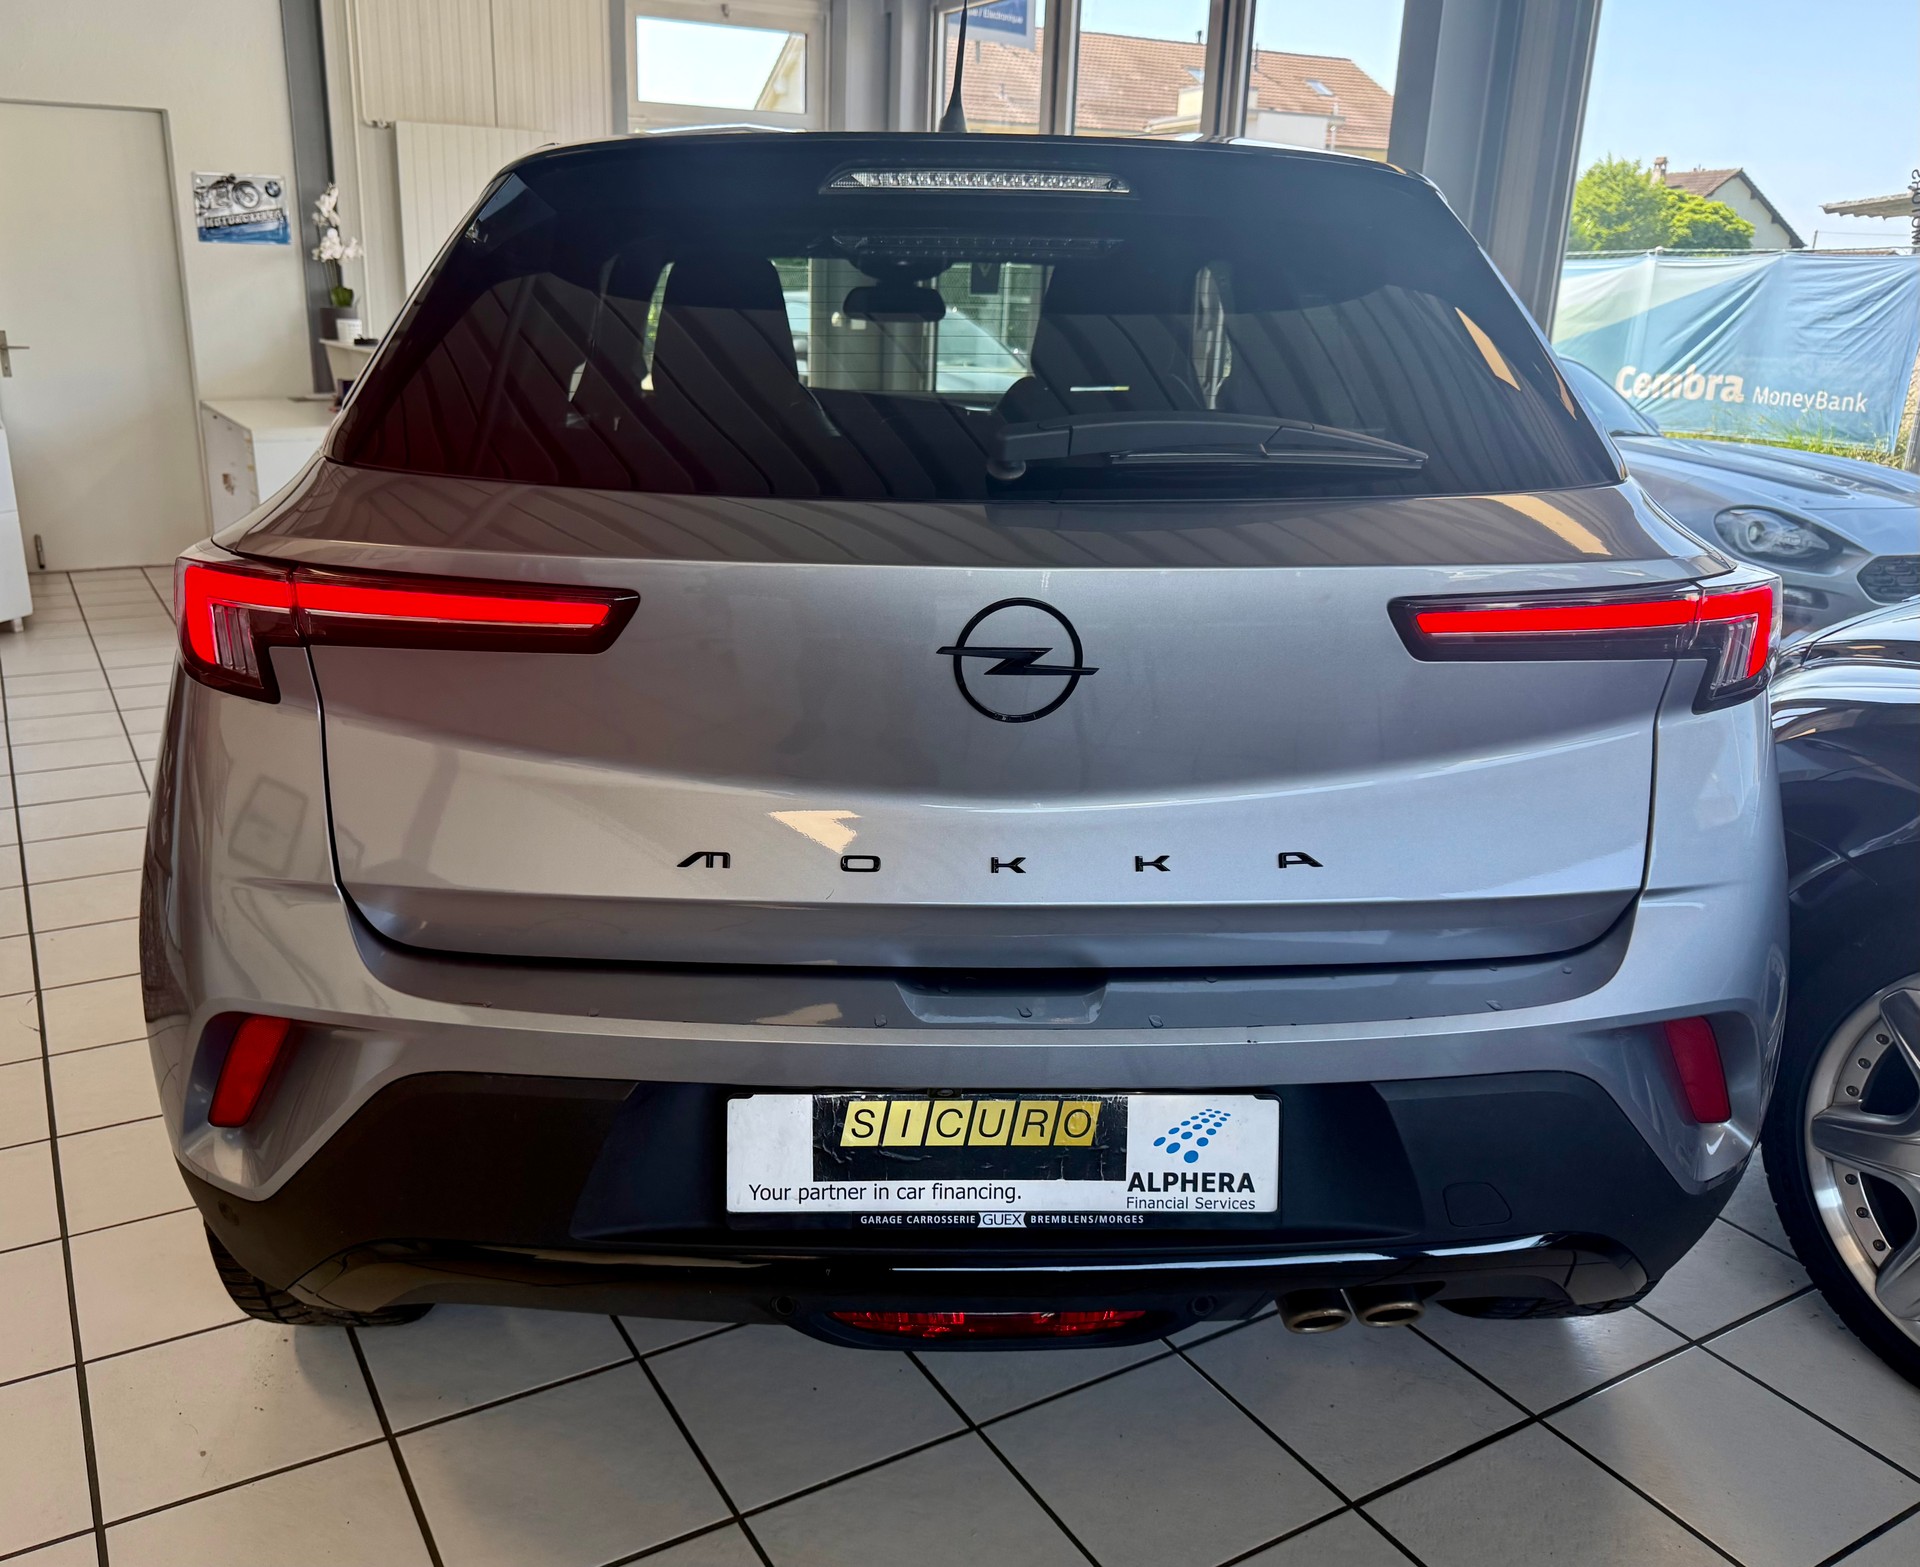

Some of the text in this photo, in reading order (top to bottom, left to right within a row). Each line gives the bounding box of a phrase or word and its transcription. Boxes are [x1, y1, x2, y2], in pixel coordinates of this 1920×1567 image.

[1615, 364, 1868, 413] Cembra MoneyBank
[676, 851, 1324, 874] MOKKA
[851, 1108, 1092, 1138] SICURO
[1127, 1172, 1256, 1193] ALPHERA
[749, 1183, 1022, 1204] Your partner in car financing.
[1126, 1197, 1256, 1210] Financial Services
[860, 1214, 1144, 1226] GARAGE CARROSSERIE GUEX BREMBLENS/MORGES
